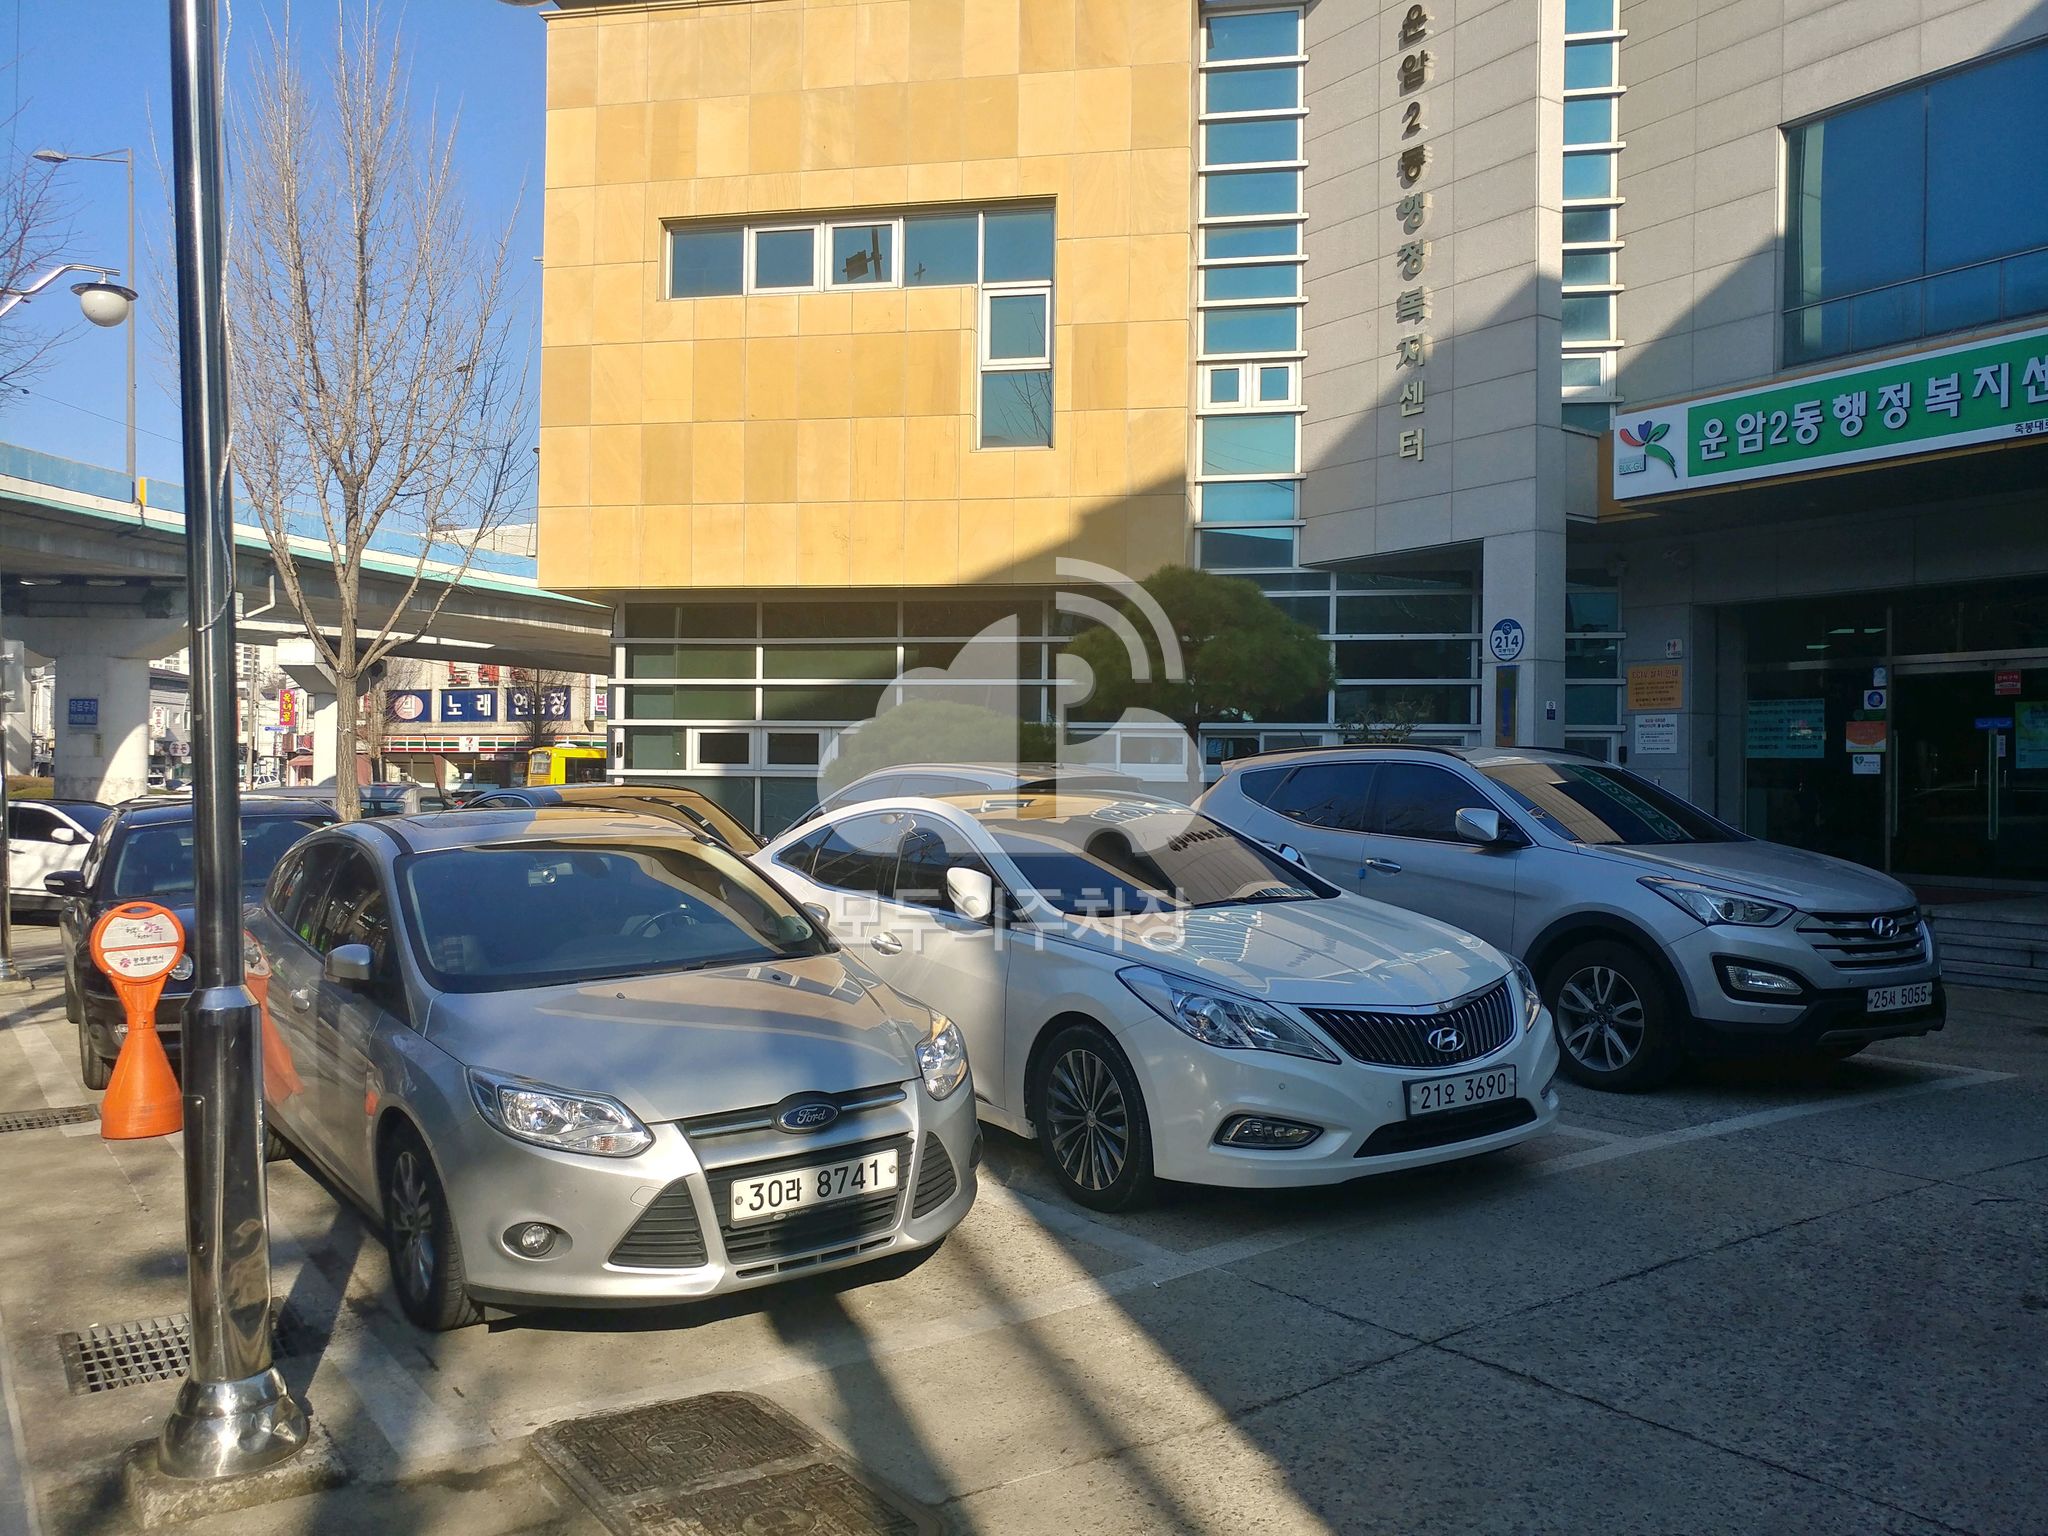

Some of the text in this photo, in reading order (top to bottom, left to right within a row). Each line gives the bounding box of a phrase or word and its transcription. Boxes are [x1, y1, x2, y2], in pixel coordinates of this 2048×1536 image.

[1400, 4, 1427, 462] 운암2동행정복지센터
[1494, 635, 1519, 649] 214
[447, 693, 492, 717] 노래
[1901, 985, 1927, 1006] 5055
[1420, 1072, 1507, 1110] 21오 3690
[796, 1106, 826, 1125] Ford
[749, 1158, 880, 1212] 30라 8741
